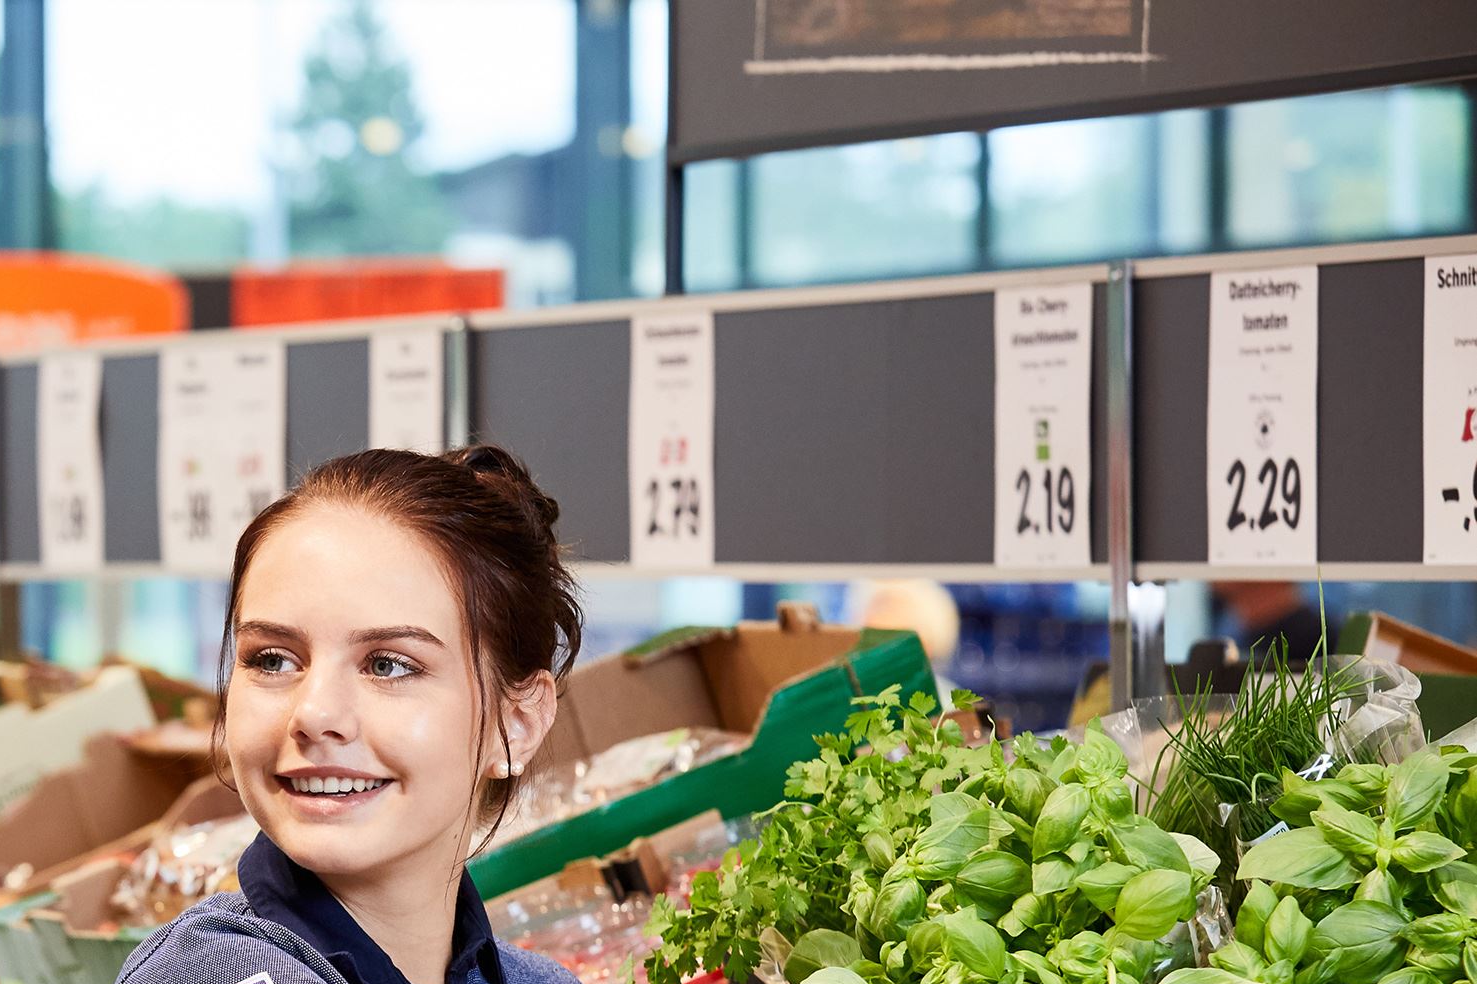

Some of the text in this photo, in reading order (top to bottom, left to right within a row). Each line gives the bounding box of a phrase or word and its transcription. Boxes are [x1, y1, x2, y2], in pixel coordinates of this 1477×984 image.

[645, 478, 700, 536] 2.79
[1016, 467, 1075, 534] 2.19
[1227, 458, 1301, 531] 2.29
